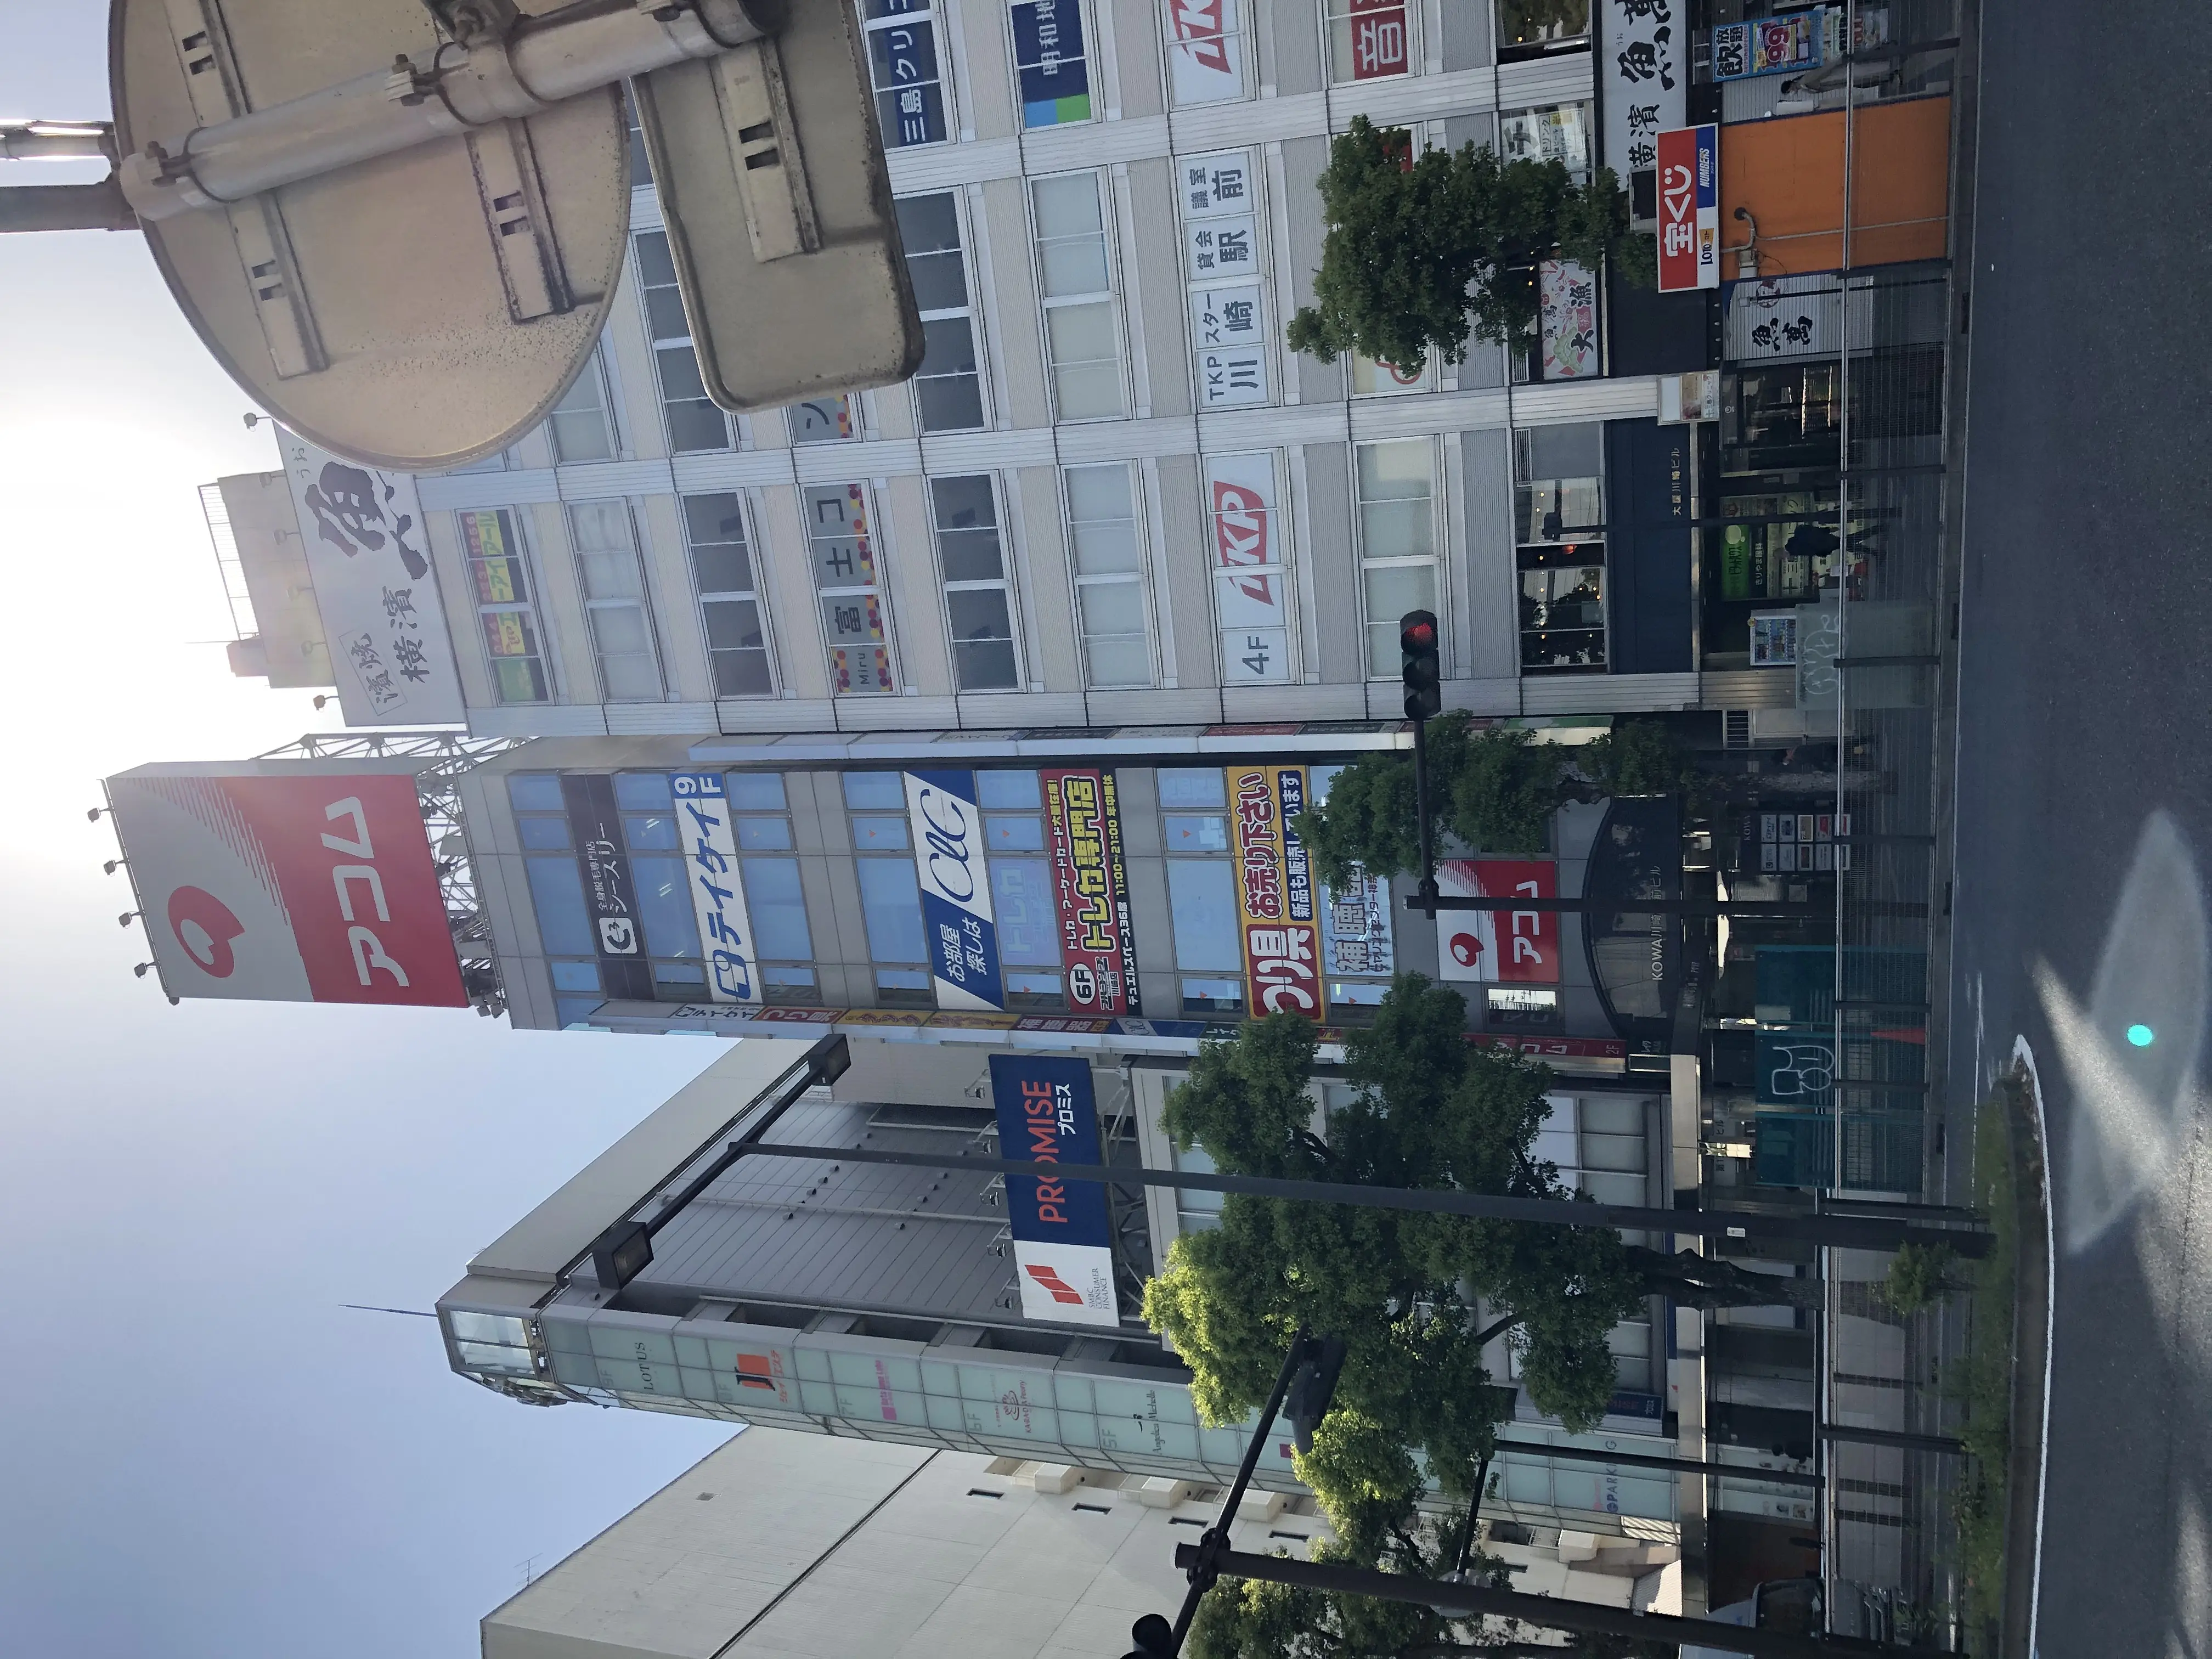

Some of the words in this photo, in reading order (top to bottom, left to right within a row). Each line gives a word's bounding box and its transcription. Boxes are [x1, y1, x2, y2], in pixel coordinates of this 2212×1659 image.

[1035, 0, 1062, 75] 明和地
[1358, 0, 1402, 71] 音
[1616, 33, 1623, 46] うお
[1699, 148, 1710, 188] NUMBERS
[1664, 165, 1694, 257] 宝くじ
[1211, 169, 1259, 389] 川崎駅前
[1201, 294, 1220, 343] スター
[1751, 315, 1813, 352] 魚萬
[1207, 356, 1225, 400] TKP
[292, 447, 311, 478] うお
[304, 461, 427, 580] 魚
[1220, 489, 1263, 596] TKP
[382, 586, 430, 683] 横濱
[1242, 635, 1269, 675] 4F
[856, 652, 870, 685] Miru
[674, 776, 721, 795] 9F
[1103, 775, 1116, 816] 年中無休
[596, 823, 628, 913] シースリー
[685, 802, 742, 945] テイケイ
[1064, 778, 1113, 949] トレカ専門店
[1236, 772, 1283, 918] お売り下さい
[320, 796, 409, 987] アコム
[585, 840, 607, 911] 全身脱毛専門店
[998, 867, 1032, 953] トレカ
[1511, 881, 1542, 964] アコム
[1650, 866, 1664, 980] KOWA川崎前ビル
[940, 923, 966, 982] お部屋
[961, 917, 988, 975] 探しは
[1118, 902, 1138, 1005] デュエルスペース36席
[1250, 928, 1314, 1013] つり具
[1074, 969, 1092, 998] 6F
[1110, 972, 1120, 995] 川崎店
[763, 1009, 838, 1022] つり具
[1605, 1045, 1619, 1054] 2F
[1055, 1084, 1076, 1136] プロミス
[1022, 1081, 1068, 1222] PROMISE
[1087, 1288, 1096, 1308] SMBC
[1092, 1267, 1103, 1309] CONSUMER
[1100, 1277, 1110, 1310] FINANCE
[1146, 1390, 1159, 1421] Michelle
[1150, 1423, 1166, 1455] Angelica
[1605, 1441, 1618, 1502] PARKIG
